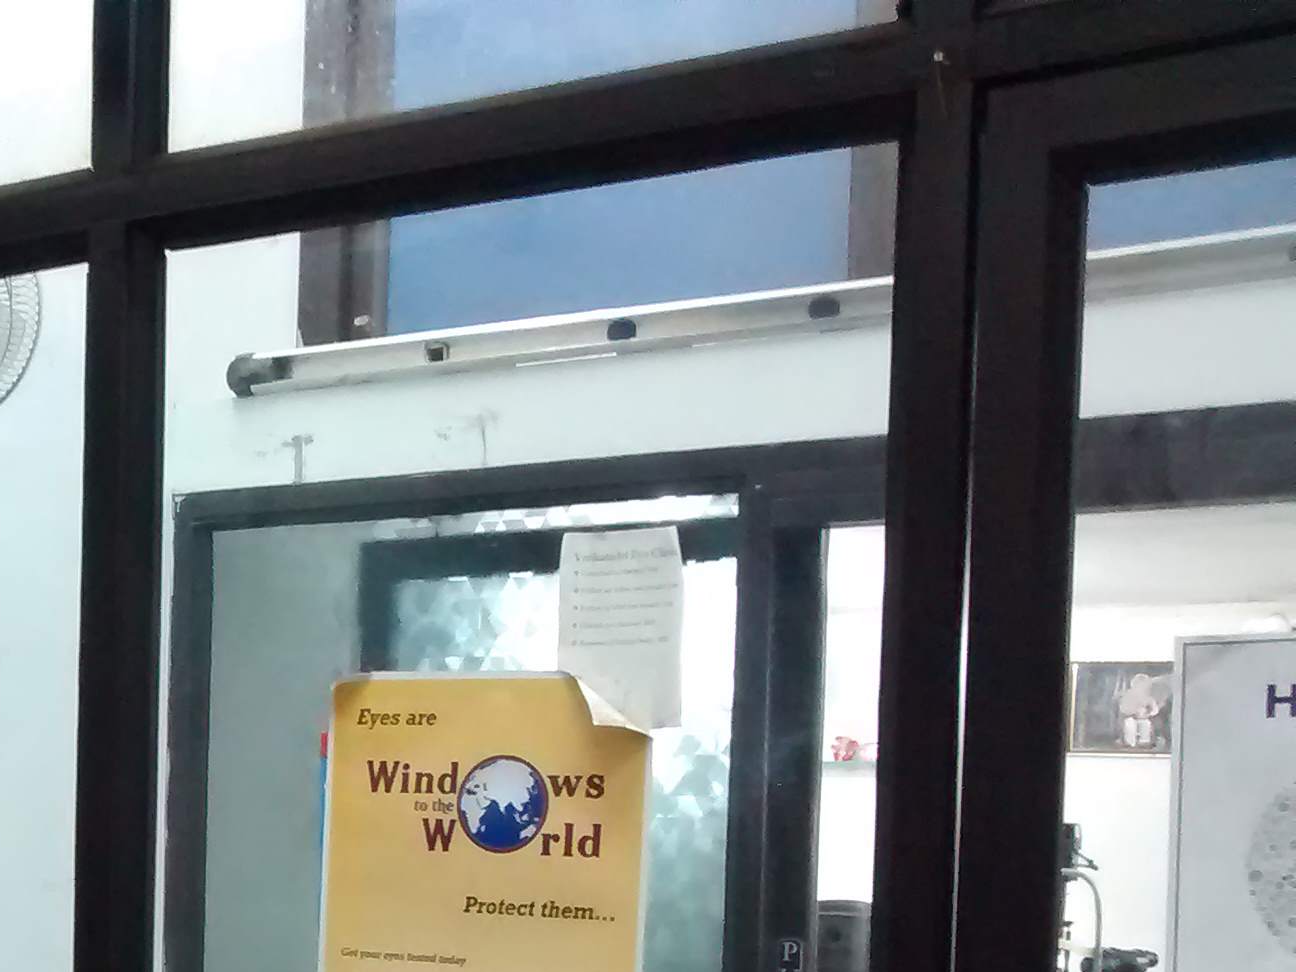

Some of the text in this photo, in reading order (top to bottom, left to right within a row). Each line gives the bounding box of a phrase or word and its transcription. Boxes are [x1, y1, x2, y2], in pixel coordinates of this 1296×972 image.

[357, 708, 437, 727] Eyes are
[414, 799, 455, 814] to the
[463, 896, 616, 922] Protect them...
